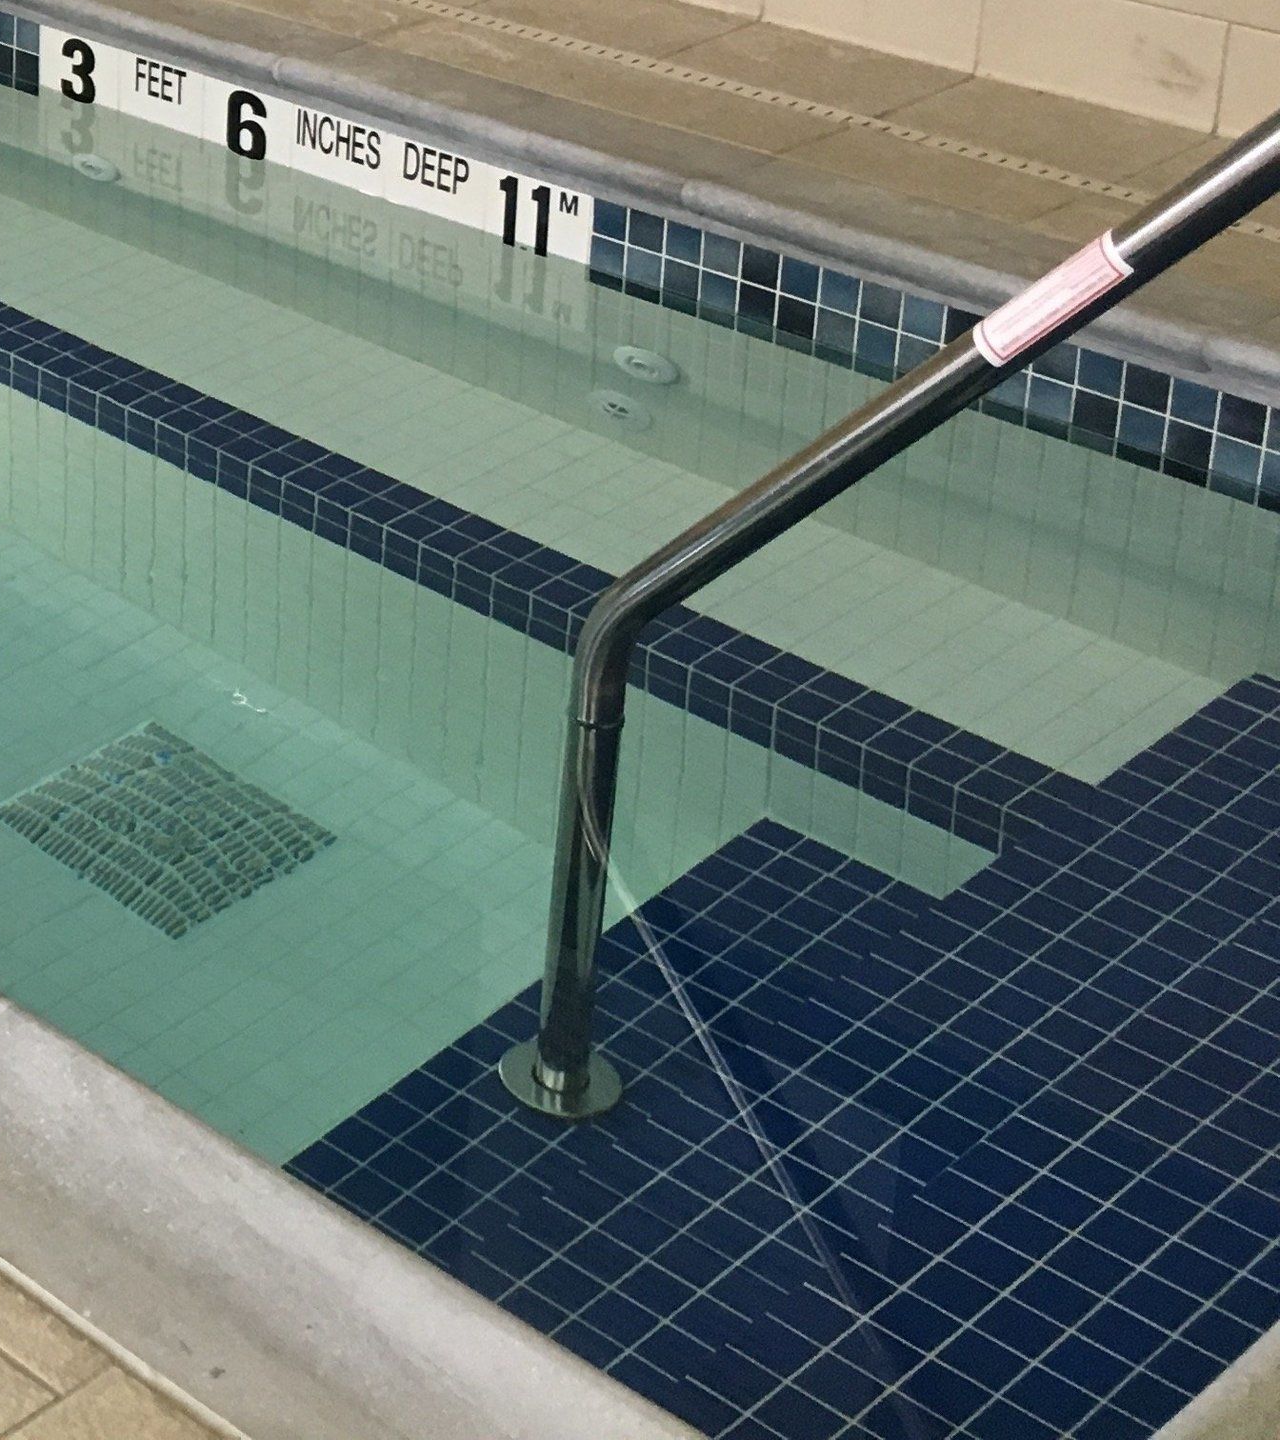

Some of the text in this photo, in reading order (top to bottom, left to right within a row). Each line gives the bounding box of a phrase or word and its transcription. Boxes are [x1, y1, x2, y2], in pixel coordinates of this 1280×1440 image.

[60, 38, 96, 104] 3
[135, 56, 187, 106] FEET
[227, 91, 268, 161] 6
[296, 108, 382, 170] INCHES
[403, 141, 470, 195] DEEP
